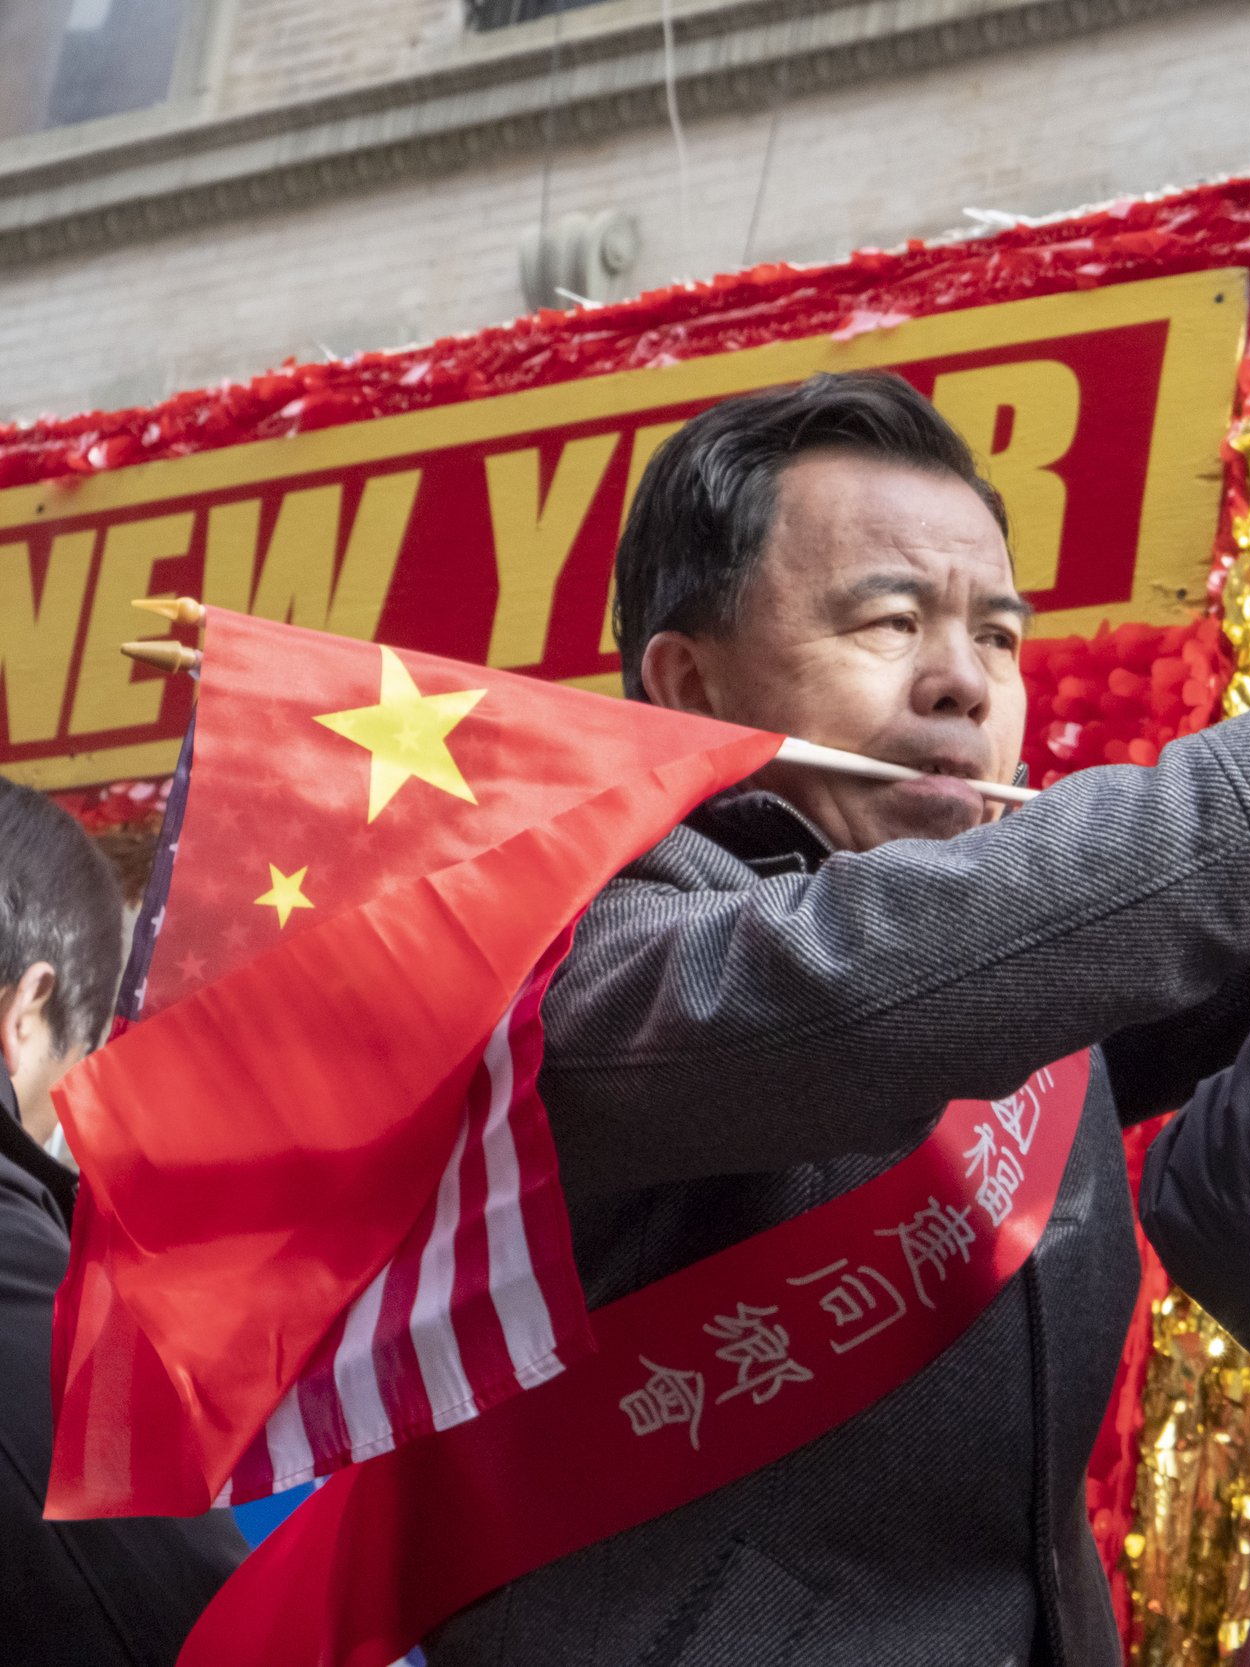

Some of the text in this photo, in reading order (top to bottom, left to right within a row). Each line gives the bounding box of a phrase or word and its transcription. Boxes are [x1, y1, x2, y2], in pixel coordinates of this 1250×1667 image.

[0, 359, 1081, 746] NEW YR
[619, 1067, 1055, 1451] 國福建同鄉會
